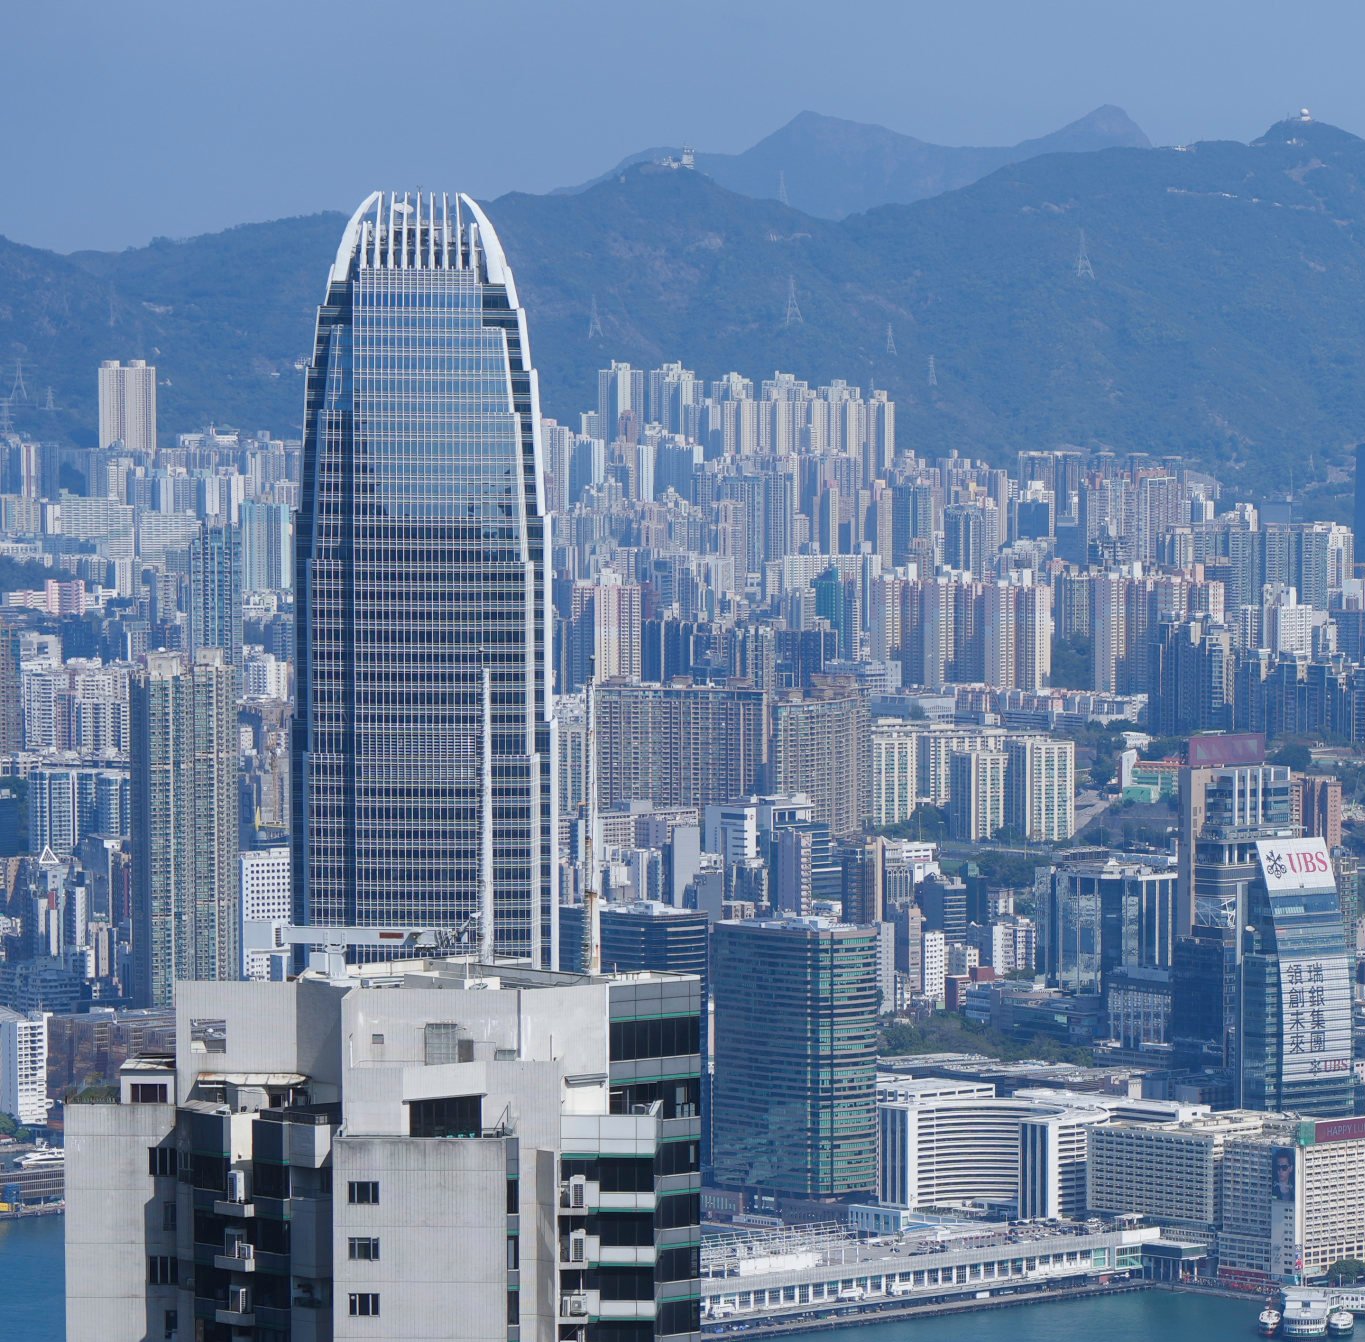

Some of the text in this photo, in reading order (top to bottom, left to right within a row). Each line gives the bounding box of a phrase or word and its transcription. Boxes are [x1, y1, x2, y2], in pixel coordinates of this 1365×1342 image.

[1286, 851, 1328, 874] UBS
[1287, 963, 1306, 1054] 領創未來
[1306, 962, 1326, 1052] 瑞銀集團
[1324, 1057, 1349, 1072] UBS
[1327, 1124, 1352, 1137] HAPPY
